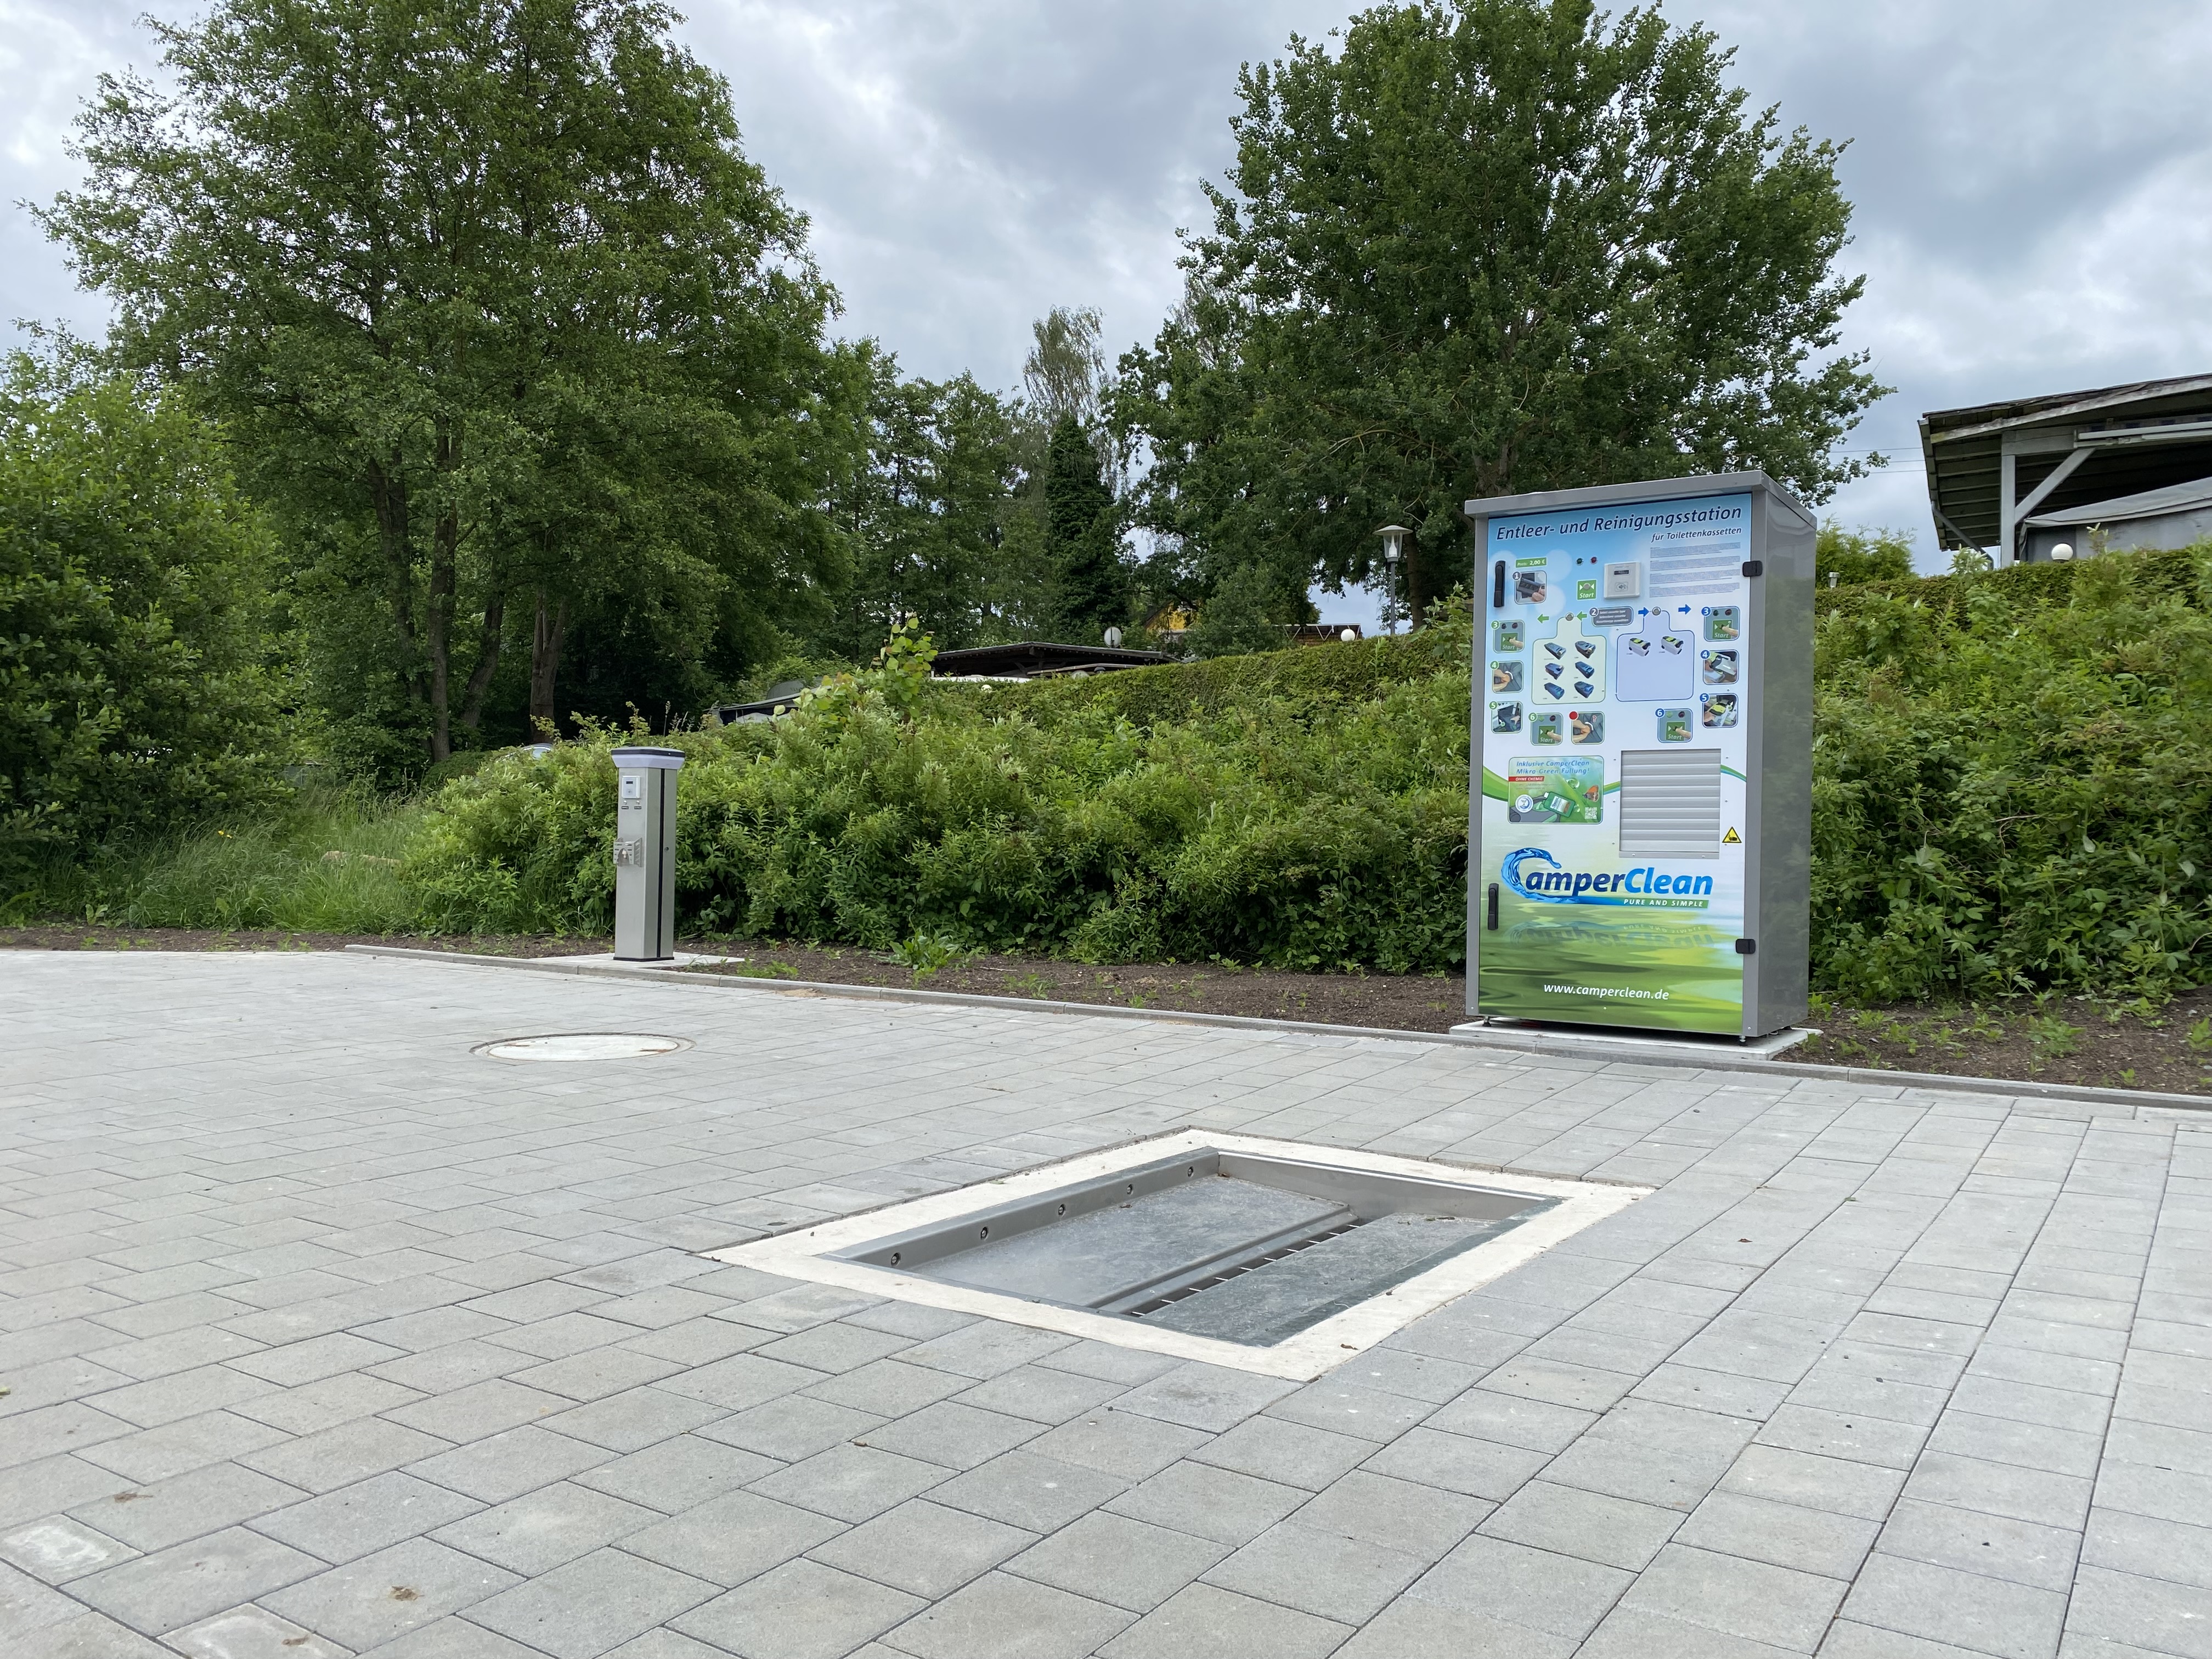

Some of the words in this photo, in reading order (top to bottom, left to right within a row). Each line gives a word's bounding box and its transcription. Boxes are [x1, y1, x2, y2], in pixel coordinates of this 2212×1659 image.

[1496, 524, 1555, 540] Entleer-
[1559, 518, 1590, 534] und
[1594, 505, 1742, 532] Reinigungsstation
[1651, 532, 1664, 543] für
[1667, 527, 1742, 540] Toilettenkassetten
[1543, 984, 1670, 1001] www.camperclean.de
